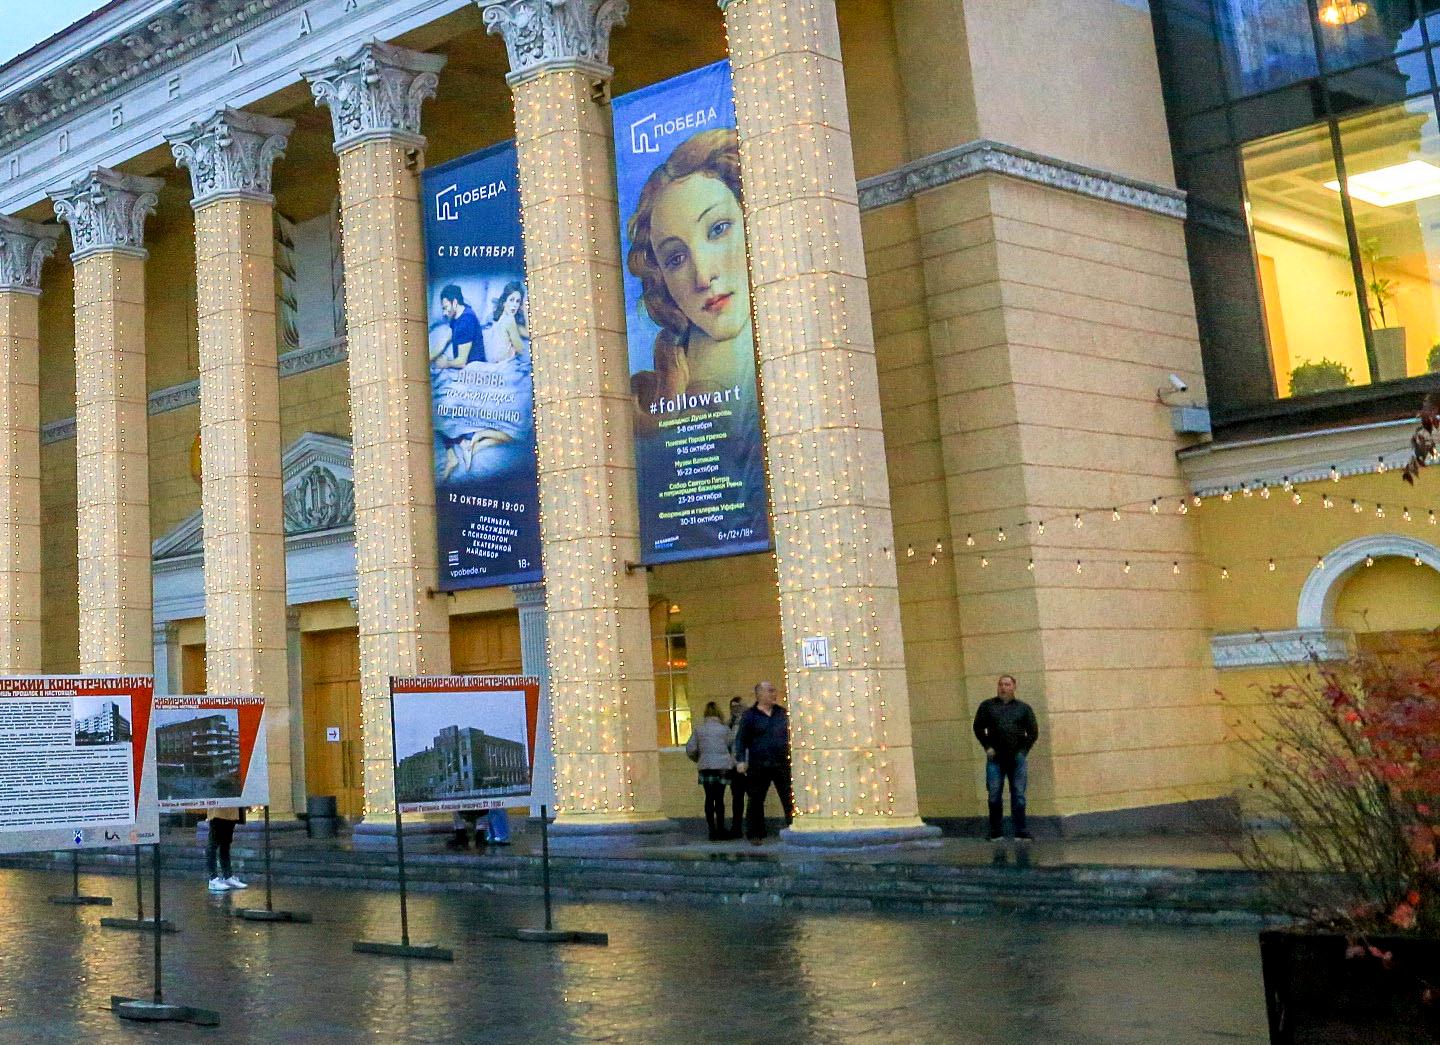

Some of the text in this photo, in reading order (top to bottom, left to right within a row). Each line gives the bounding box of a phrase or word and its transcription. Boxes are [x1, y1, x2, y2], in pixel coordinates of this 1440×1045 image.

[654, 106, 717, 138] ПОБЕДА
[454, 180, 506, 207] ПОБЕДА
[438, 245, 515, 257] С 13 ОКТЯБРЯ
[649, 385, 741, 414] #followart
[449, 493, 525, 513] 12 ОКТЯБРЯ 19:00
[479, 515, 511, 527] ПРЕМЬЕРА
[467, 530, 509, 543] ПСИХОЛОГОМ
[476, 523, 518, 537] ОБСУЖДЕНИЕ
[466, 546, 499, 559] МАЙДИБОР
[472, 540, 512, 552] ЕКАТЕРИНОЙ
[518, 558, 531, 569] 18+
[450, 566, 487, 578] vpobede.ru
[49, 676, 154, 690] КОНСТРУКТИВИЗМ
[392, 676, 540, 688] НОВОСИБИРСКИЙ КОНСТРУКТИВИЗМ
